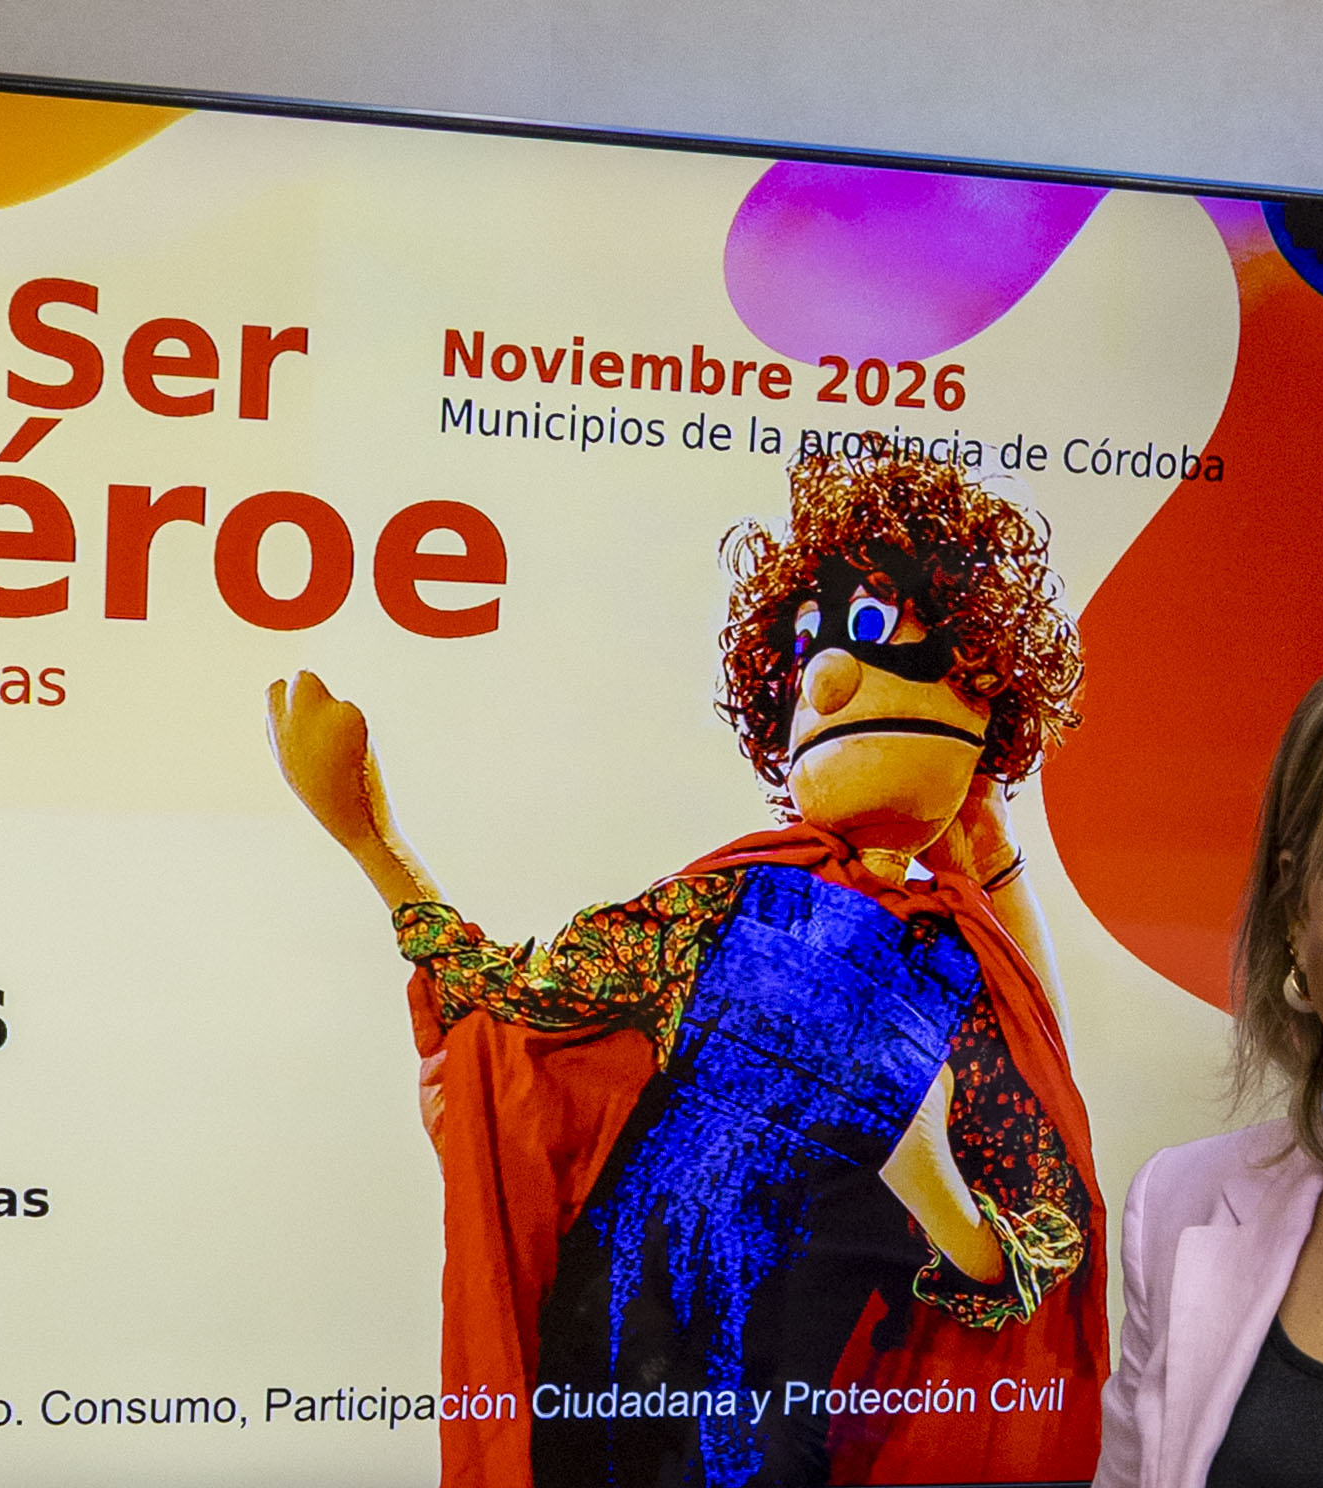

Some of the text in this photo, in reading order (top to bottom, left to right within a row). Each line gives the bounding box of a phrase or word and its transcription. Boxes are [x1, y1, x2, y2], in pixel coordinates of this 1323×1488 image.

[7, 278, 308, 422] Ser
[442, 329, 966, 412] Noviembre 2026
[442, 398, 1226, 482] Municipios de la provincia de Córdoba
[42, 1390, 249, 1434] Consumo,
[264, 1385, 517, 1430] Participación
[531, 1381, 738, 1420] Ciudadana
[749, 1391, 770, 1426] y
[784, 1377, 979, 1417] Protección
[989, 1377, 1065, 1414] Civil
